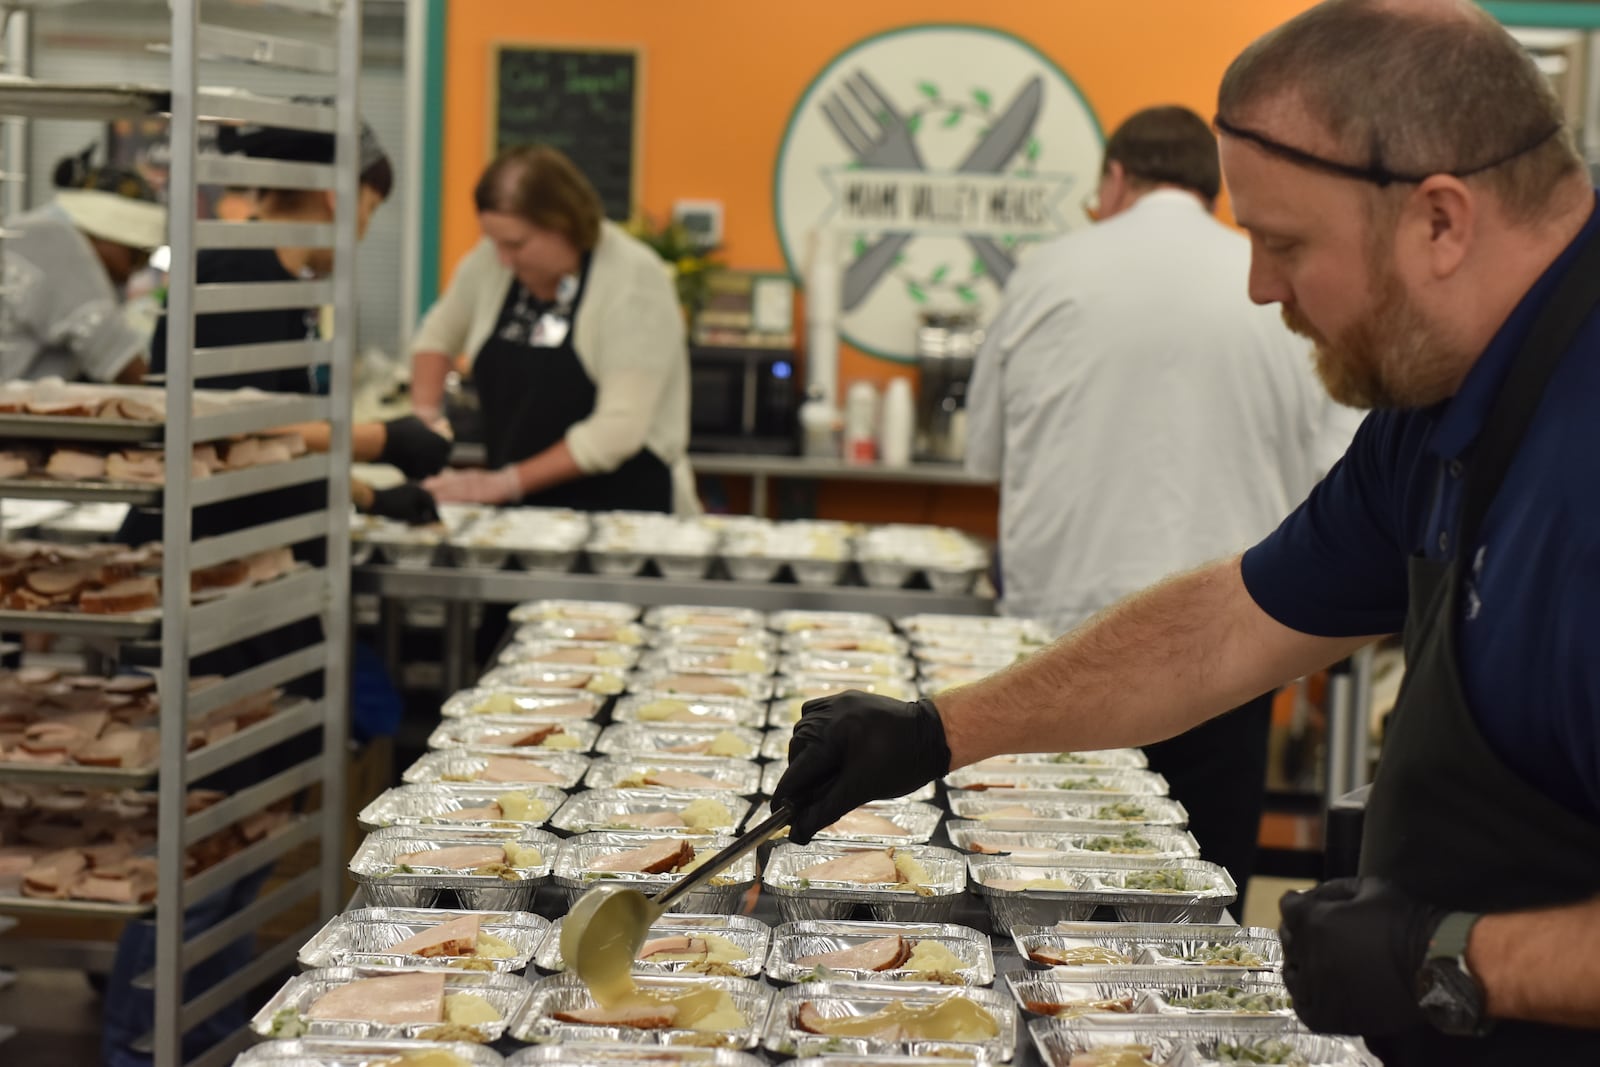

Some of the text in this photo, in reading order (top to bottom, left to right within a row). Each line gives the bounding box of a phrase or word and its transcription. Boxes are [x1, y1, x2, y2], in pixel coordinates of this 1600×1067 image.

[846, 181, 1047, 226] MIAMI VALLEY MEALS
